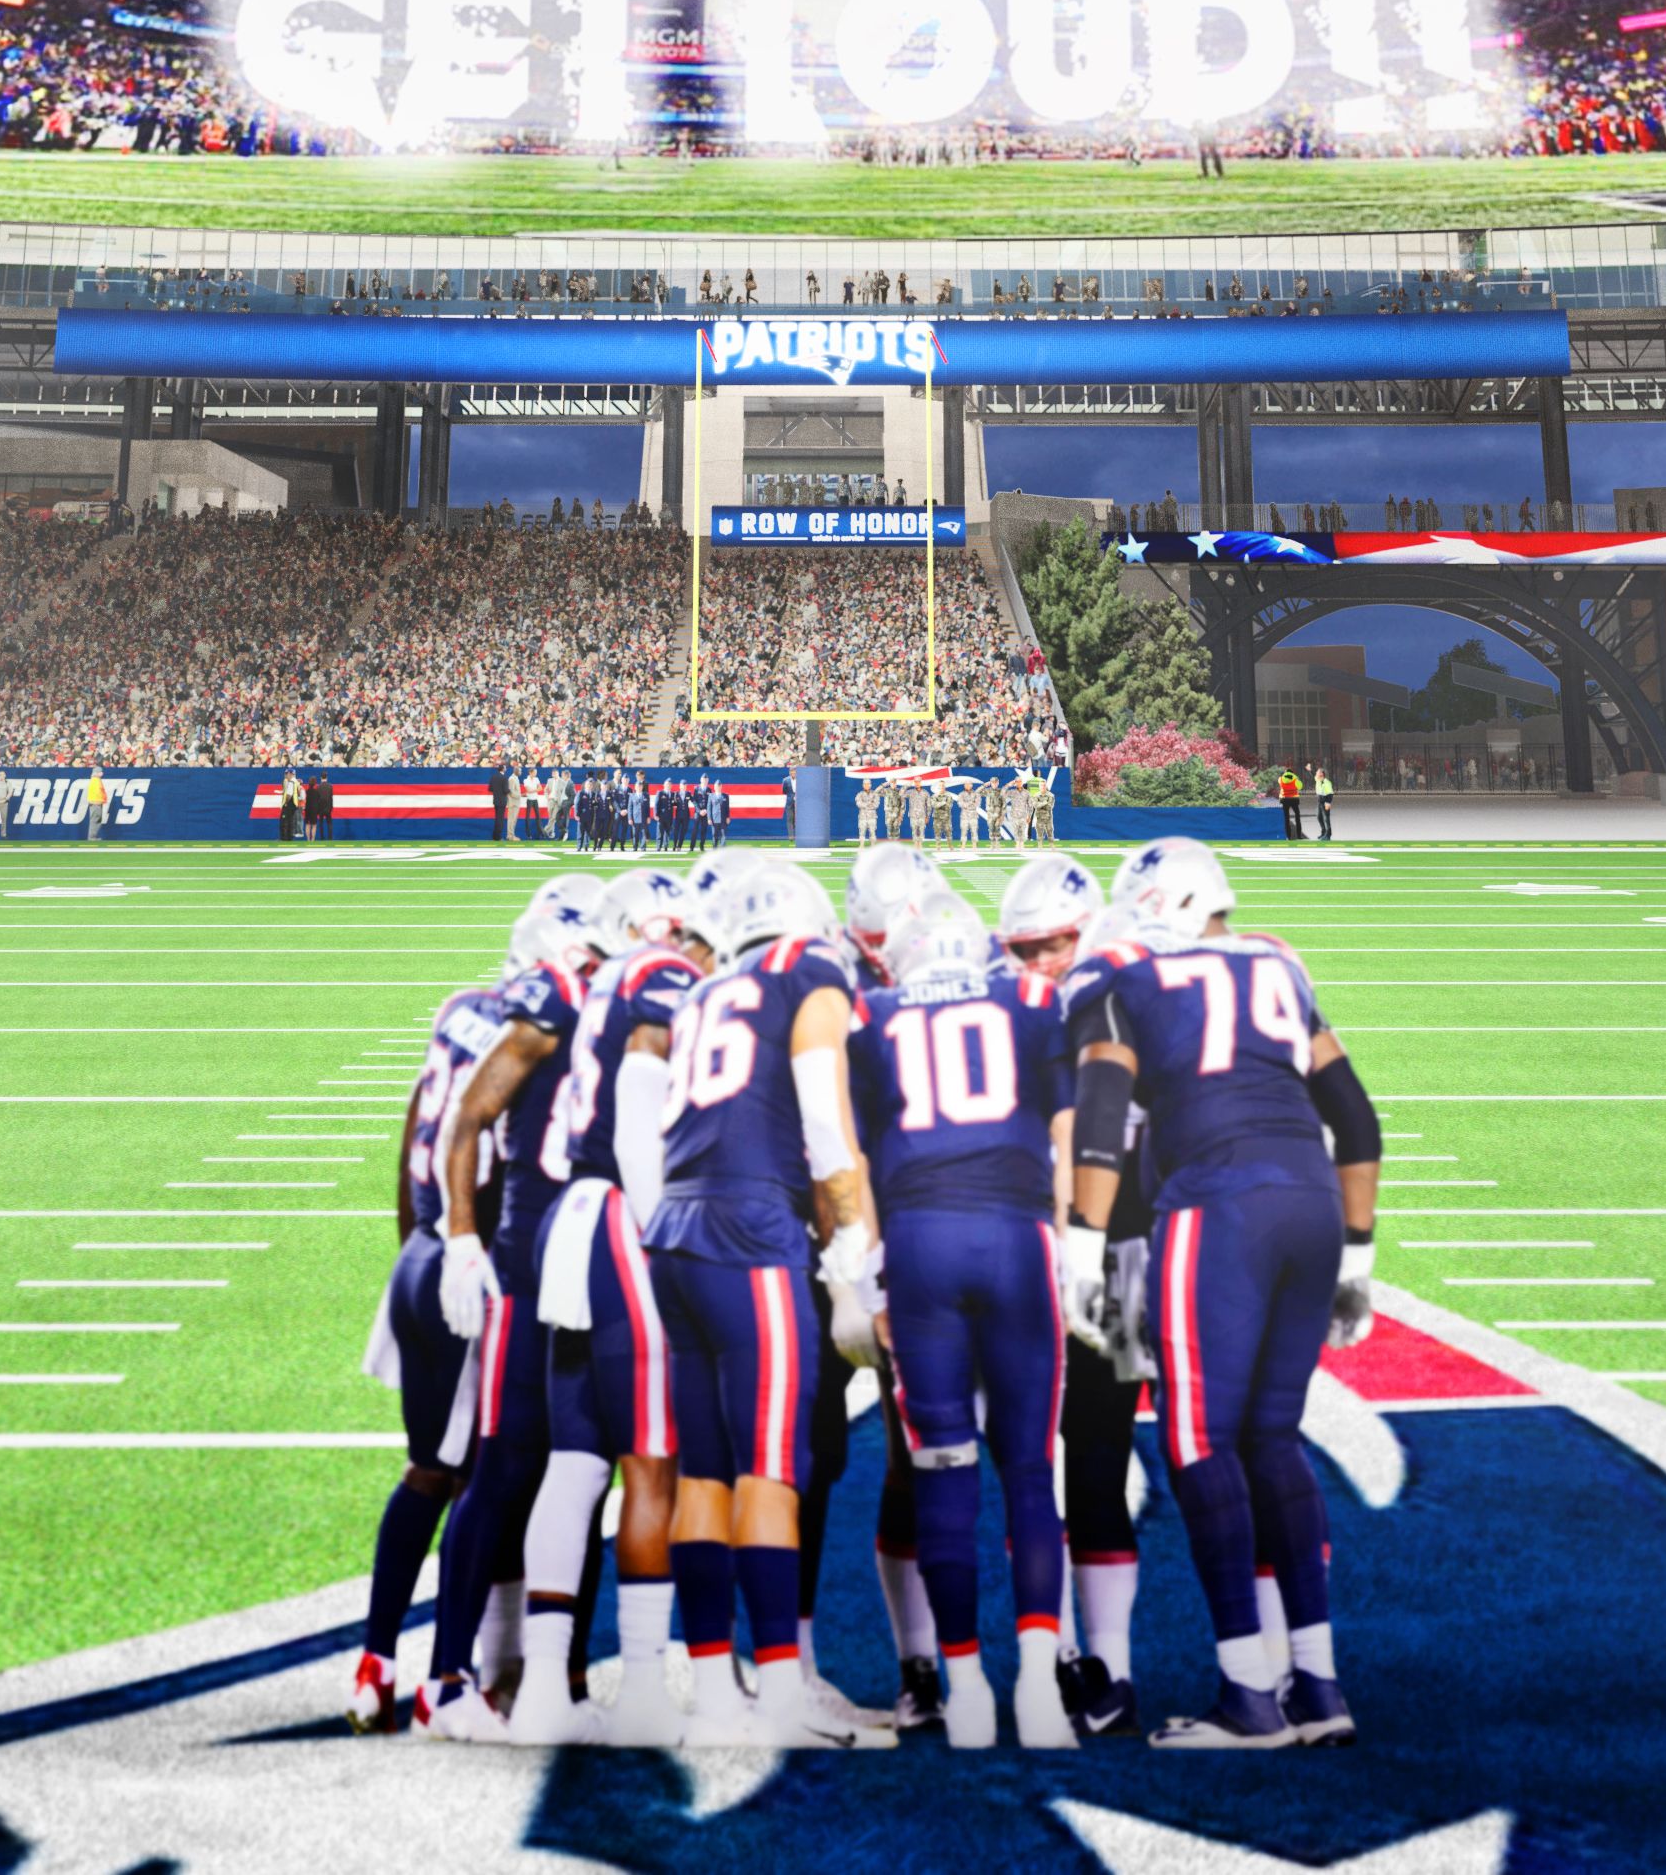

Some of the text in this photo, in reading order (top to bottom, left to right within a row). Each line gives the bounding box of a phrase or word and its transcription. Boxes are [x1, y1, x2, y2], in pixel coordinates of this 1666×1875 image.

[714, 321, 935, 373] PATRIOTS
[741, 513, 934, 534] ROW OF HONOR
[898, 977, 989, 1006] JONES
[1153, 954, 1313, 1077] 74
[884, 1000, 1020, 1131] 10
